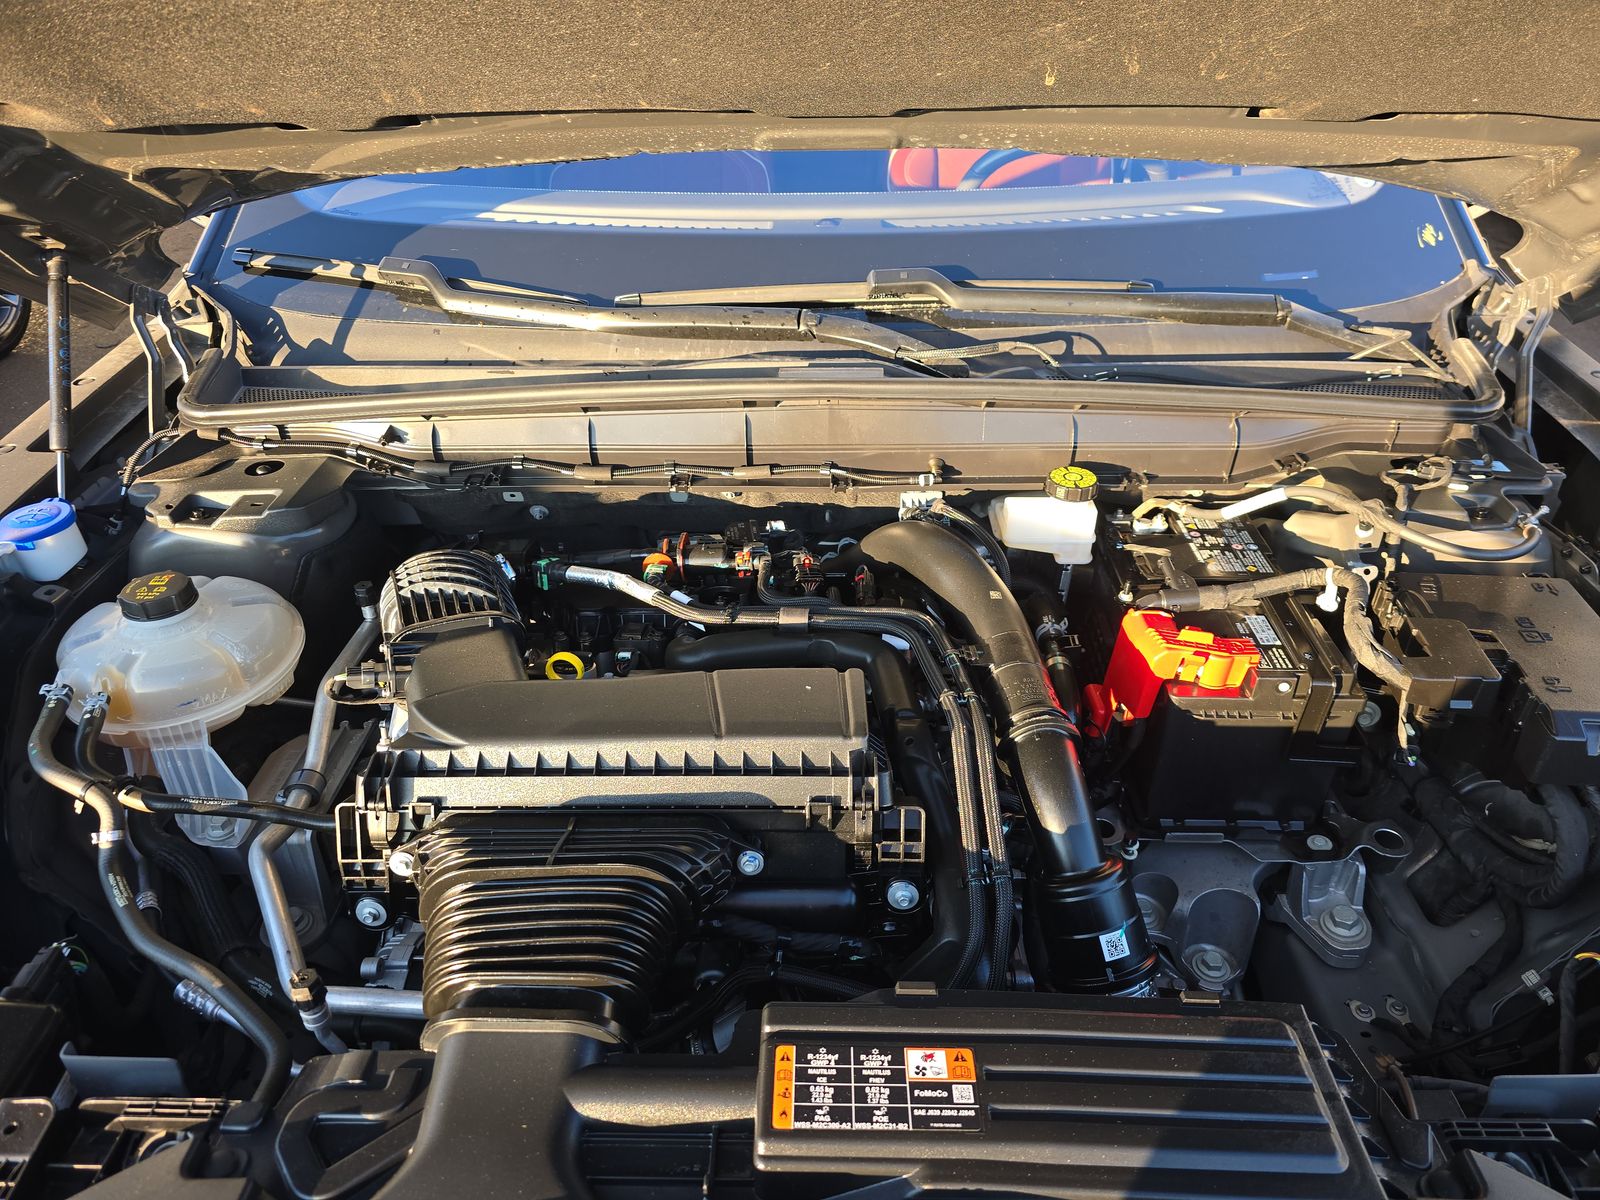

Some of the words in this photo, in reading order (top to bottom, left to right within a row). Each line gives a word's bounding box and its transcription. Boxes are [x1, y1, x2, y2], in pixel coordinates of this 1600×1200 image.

[824, 1085, 835, 1095] kg
[880, 1086, 890, 1095] kg
[913, 1089, 948, 1098] FoMoCo
[913, 1108, 926, 1116] SAE
[814, 1114, 831, 1122] PAG
[872, 1115, 889, 1123] POE
